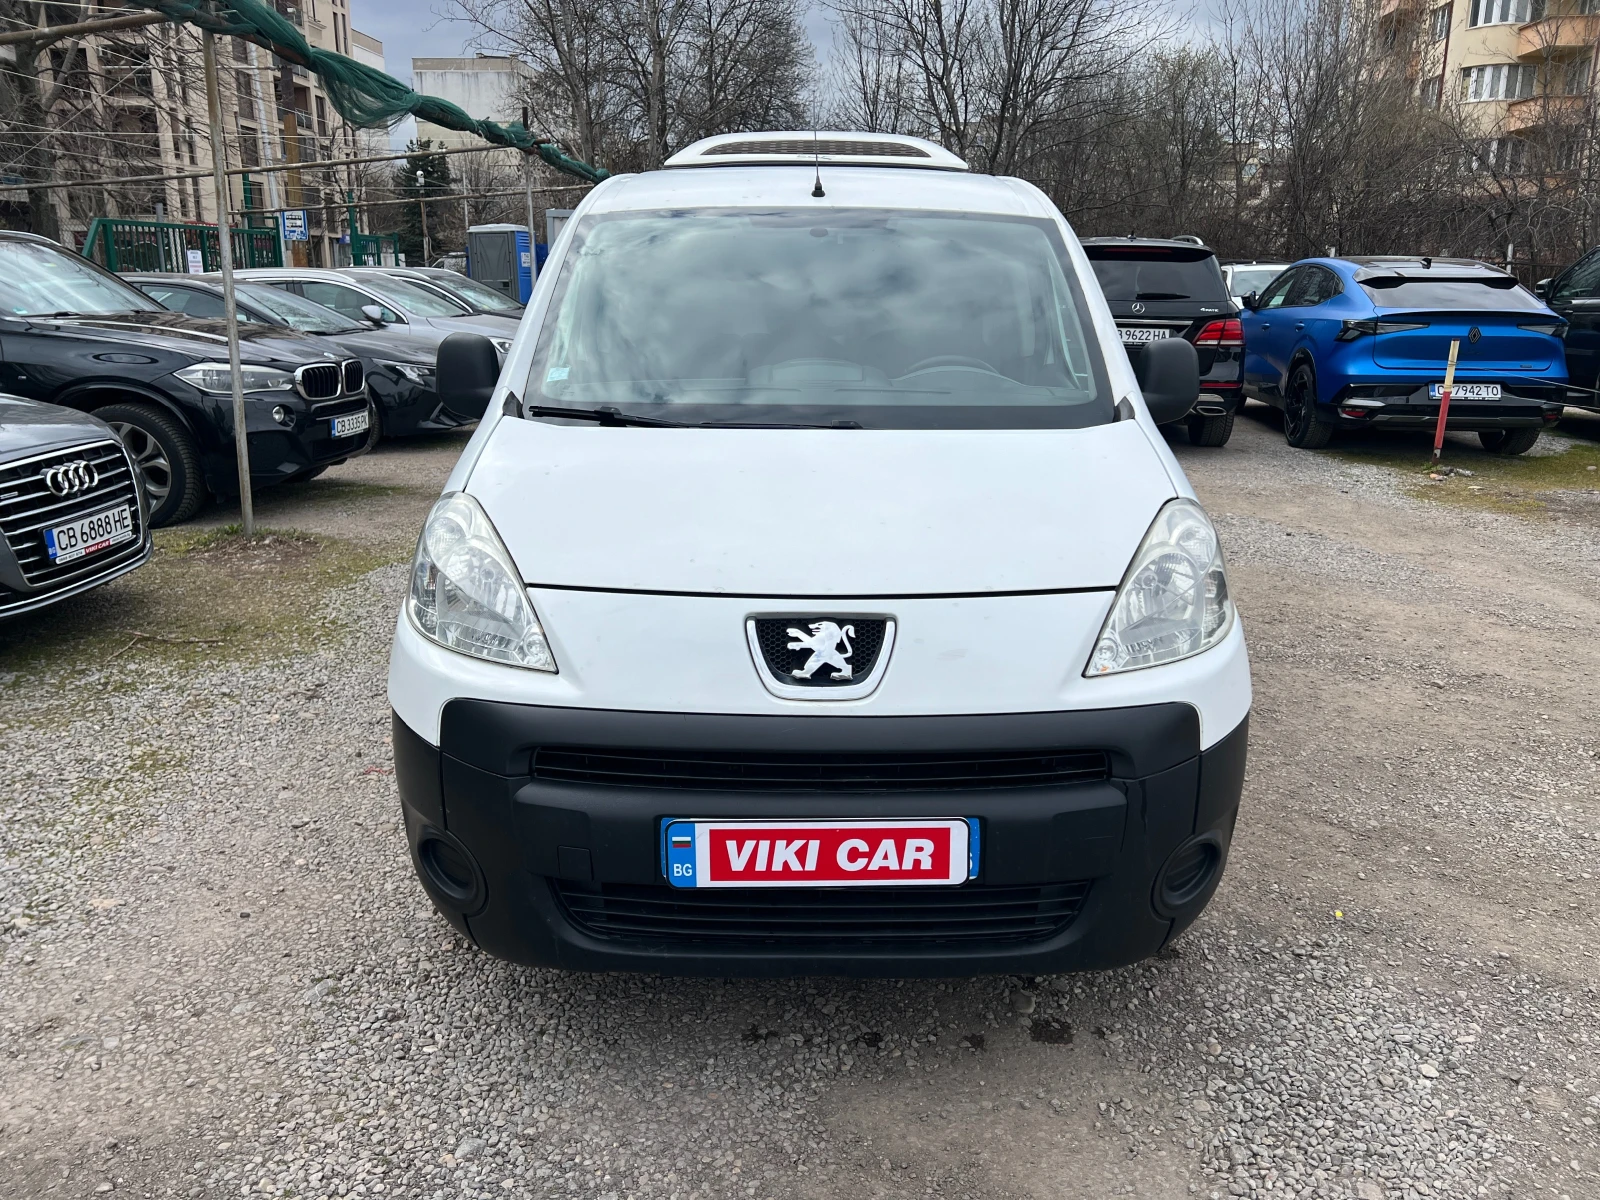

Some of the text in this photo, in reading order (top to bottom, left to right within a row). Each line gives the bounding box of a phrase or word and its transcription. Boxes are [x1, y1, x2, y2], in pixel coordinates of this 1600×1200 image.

[1125, 329, 1151, 341] 9622
[1153, 330, 1167, 340] HA
[1452, 385, 1482, 396] 7942
[56, 526, 78, 551] CB
[80, 514, 113, 544] 6888
[112, 508, 130, 533] HE
[725, 839, 820, 872] VIKI
[835, 838, 935, 871] CAR
[673, 863, 693, 877] BG
